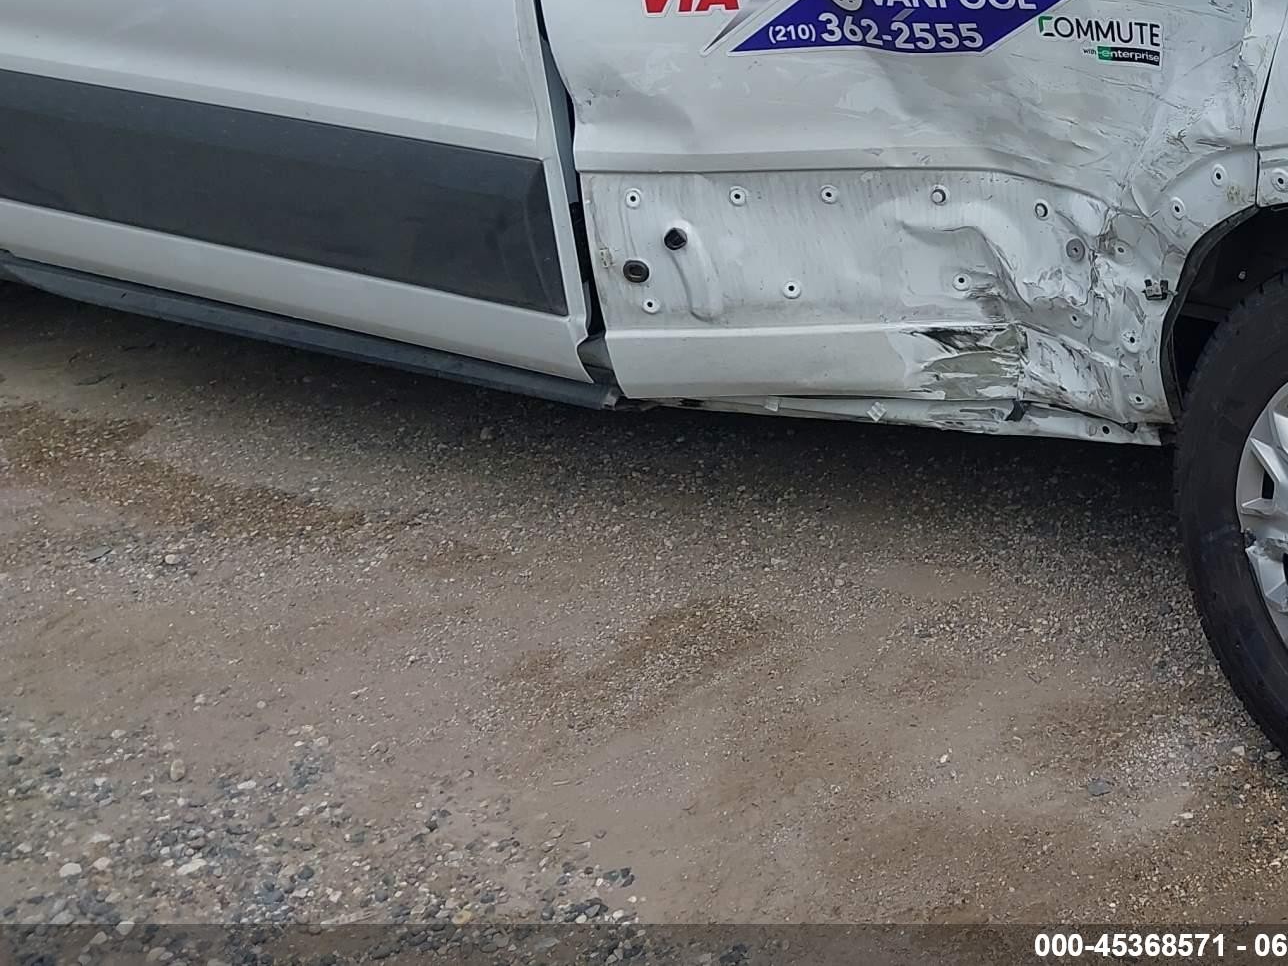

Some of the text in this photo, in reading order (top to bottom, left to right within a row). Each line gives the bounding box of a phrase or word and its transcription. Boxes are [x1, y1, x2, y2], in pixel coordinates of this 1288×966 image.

[768, 12, 983, 50] (210) 362-2555
[1038, 15, 1161, 47] COMMUTE
[1101, 48, 1160, 62] enterprise
